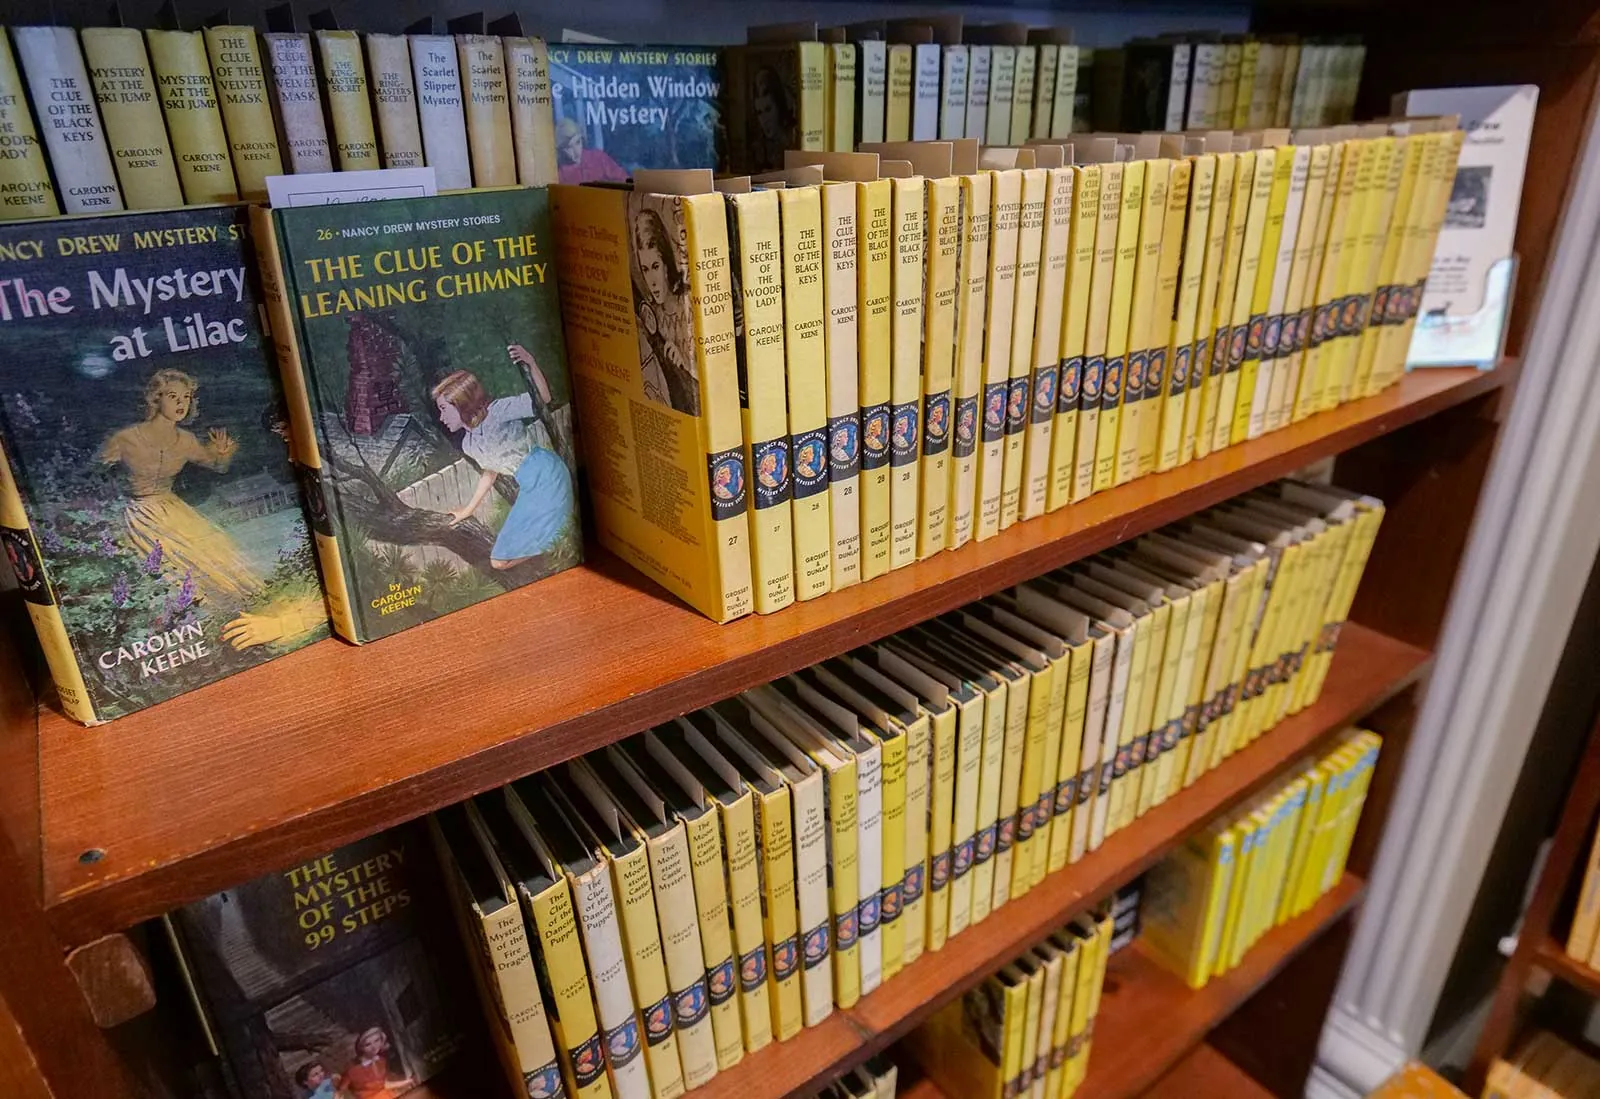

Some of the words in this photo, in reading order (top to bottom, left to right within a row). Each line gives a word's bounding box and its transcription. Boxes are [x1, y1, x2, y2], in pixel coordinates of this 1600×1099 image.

[219, 38, 246, 48] THE
[221, 53, 251, 62] CLUE
[428, 52, 446, 63] The
[478, 51, 493, 60] The
[522, 54, 538, 64] The
[577, 51, 612, 64] DREW
[619, 52, 668, 64] MYSTERY
[674, 53, 717, 65] STORIES
[91, 68, 145, 78] MYSTERY
[216, 67, 233, 77] OF
[236, 67, 261, 76] THE
[422, 66, 455, 77] Scarlet
[471, 65, 501, 75] Scarlet
[518, 67, 546, 77] Scarlet
[50, 78, 77, 88] THE
[101, 81, 118, 90] AT
[120, 81, 144, 90] THE
[160, 76, 212, 85] MYSTERY
[219, 80, 262, 90] VELVET
[424, 80, 456, 92] Slipper
[472, 78, 502, 89] Slipper
[518, 81, 547, 92] Slipper
[572, 76, 640, 98] Hidden
[649, 76, 720, 97] Window
[51, 92, 83, 101] CLUE
[96, 93, 117, 103] SKI
[121, 92, 152, 103] JUMP
[169, 88, 184, 97] AT
[187, 88, 210, 96] THE
[282, 92, 316, 101] MASK
[471, 92, 505, 104] Mystery
[166, 101, 185, 109] SKI
[188, 99, 216, 110] JUMP
[226, 94, 263, 104] MASK
[423, 95, 460, 107] Mystery
[517, 94, 549, 106] Mystery
[48, 105, 67, 115] OF
[69, 104, 93, 114] THE
[586, 102, 669, 131] Mystery
[53, 118, 94, 128] BLACK
[63, 132, 94, 142] KEYS
[233, 142, 276, 151] CAROLYN
[339, 143, 375, 151] CAROLYN
[116, 148, 162, 158] CAROLYN
[182, 153, 226, 162] CAROLYN
[244, 152, 272, 160] KEENE
[128, 160, 159, 168] KEENE
[193, 164, 221, 172] KEENE
[0, 182, 52, 192] AROLYN
[69, 185, 116, 196] CAROLYN
[4, 195, 46, 205] KEENE
[82, 197, 112, 206] KEENE
[873, 208, 886, 217] THE
[905, 212, 917, 221] THE
[838, 216, 852, 225] THE
[872, 218, 887, 228] CLUE
[316, 228, 333, 241] 26
[342, 225, 380, 238] NANCY
[383, 223, 413, 234] DREW
[416, 219, 460, 231] MYSTERY
[462, 215, 500, 226] STORIES
[836, 227, 853, 236] CLUE
[903, 223, 919, 232] CLUE
[800, 229, 815, 239] THE
[0, 240, 44, 261] NCY
[57, 234, 121, 256] DREW
[134, 225, 218, 249] MYSTERY
[756, 241, 771, 250] THE
[798, 240, 816, 250] CLUE
[869, 240, 888, 251] BLACK
[900, 244, 920, 253] BLACK
[703, 247, 718, 258] THE
[750, 251, 778, 263] SECRET
[794, 253, 804, 262] OF
[806, 250, 820, 261] THE
[833, 249, 855, 259] BLACK
[872, 251, 887, 262] KEYS
[304, 255, 364, 284] THE
[373, 246, 443, 275] CLUE
[451, 240, 486, 265] OF
[493, 234, 537, 259] THE
[696, 258, 726, 271] SECRET
[903, 254, 918, 264] KEYS
[760, 264, 771, 273] OF
[795, 262, 819, 274] BLACK
[836, 260, 854, 271] KEYS
[707, 271, 718, 281] OF
[758, 275, 773, 285] THE
[799, 274, 817, 285] KEYS
[301, 279, 427, 319] LEANING
[436, 263, 548, 299] CHIMNEY
[705, 282, 720, 292] THE
[0, 278, 74, 321] The
[87, 267, 246, 315] Mystery
[756, 297, 777, 308] LADY
[704, 304, 726, 316] LADY
[795, 319, 822, 331] CAROLYN
[109, 326, 152, 362] at
[164, 312, 248, 352] Lilac
[698, 331, 734, 345] CAROLYN
[800, 329, 818, 340] KEENE
[756, 335, 781, 346] KEENE
[705, 344, 730, 355] KEENE
[760, 442, 776, 453] NANCY
[844, 486, 852, 495] 28
[728, 536, 738, 546] 27
[805, 551, 828, 563] GROSSET
[807, 565, 828, 576] DUNLAP
[768, 574, 790, 586] GROSSET
[389, 583, 400, 592] by
[725, 586, 749, 599] GROSSET
[769, 587, 789, 598] DUNLAP
[371, 585, 422, 609] CAROLYN
[380, 598, 416, 615] KEENE
[727, 600, 748, 611] DUNLAP
[98, 621, 204, 670] CAROLYN
[141, 641, 210, 677] KEENE
[662, 844, 675, 854] The
[628, 857, 642, 869] The
[661, 859, 681, 873] stone
[284, 854, 337, 889] THE
[661, 867, 682, 881] Castle
[294, 845, 406, 910] MYSTERY
[659, 872, 687, 892] Mystery
[587, 879, 601, 891] The
[629, 881, 649, 895] Castle
[549, 892, 564, 904] The
[587, 887, 605, 901] Clue
[299, 902, 335, 929] OF
[341, 878, 391, 909] THE
[597, 894, 609, 906] the
[549, 900, 568, 915] Clue
[560, 908, 572, 919] the
[305, 924, 335, 951] 99
[343, 889, 411, 933] STEPS
[497, 917, 514, 929] The
[510, 934, 523, 943] the
[504, 947, 522, 959] Fire
[498, 952, 530, 971] Dragon
